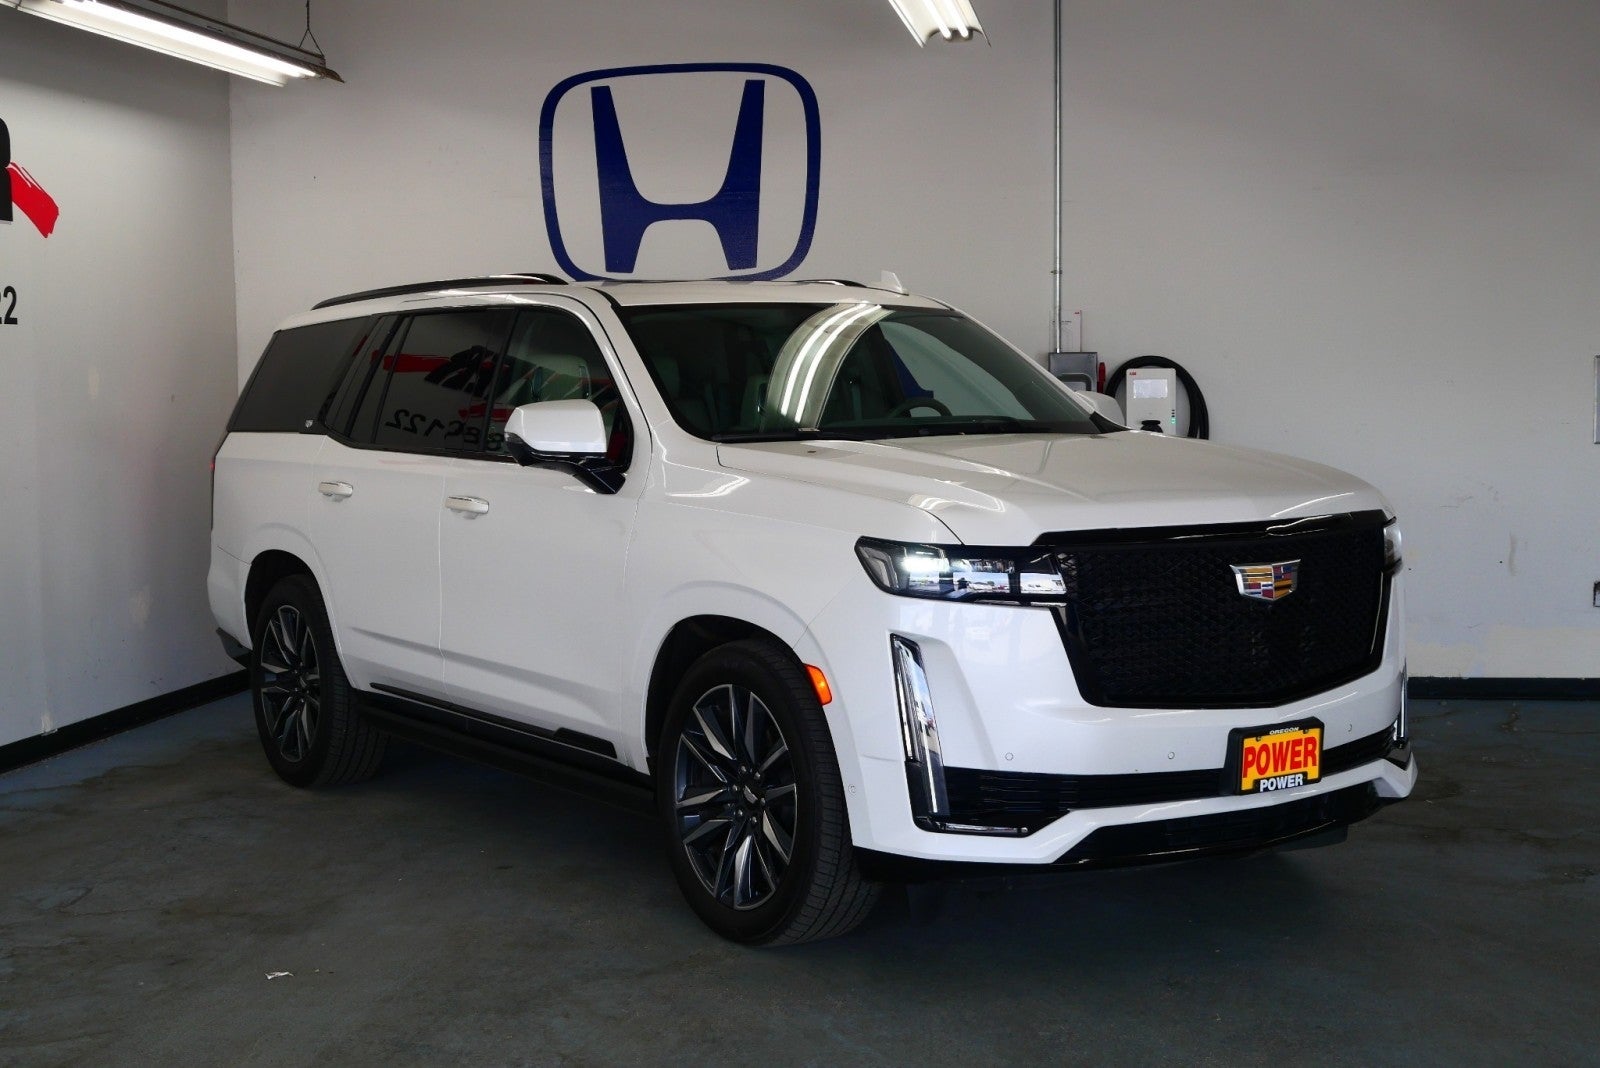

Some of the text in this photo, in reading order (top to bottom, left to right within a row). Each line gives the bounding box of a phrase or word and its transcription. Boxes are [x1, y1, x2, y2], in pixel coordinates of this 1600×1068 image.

[0, 285, 18, 325] 2
[1269, 726, 1300, 735] OREGON
[1242, 736, 1318, 778] POWER
[1259, 773, 1304, 792] POWER
